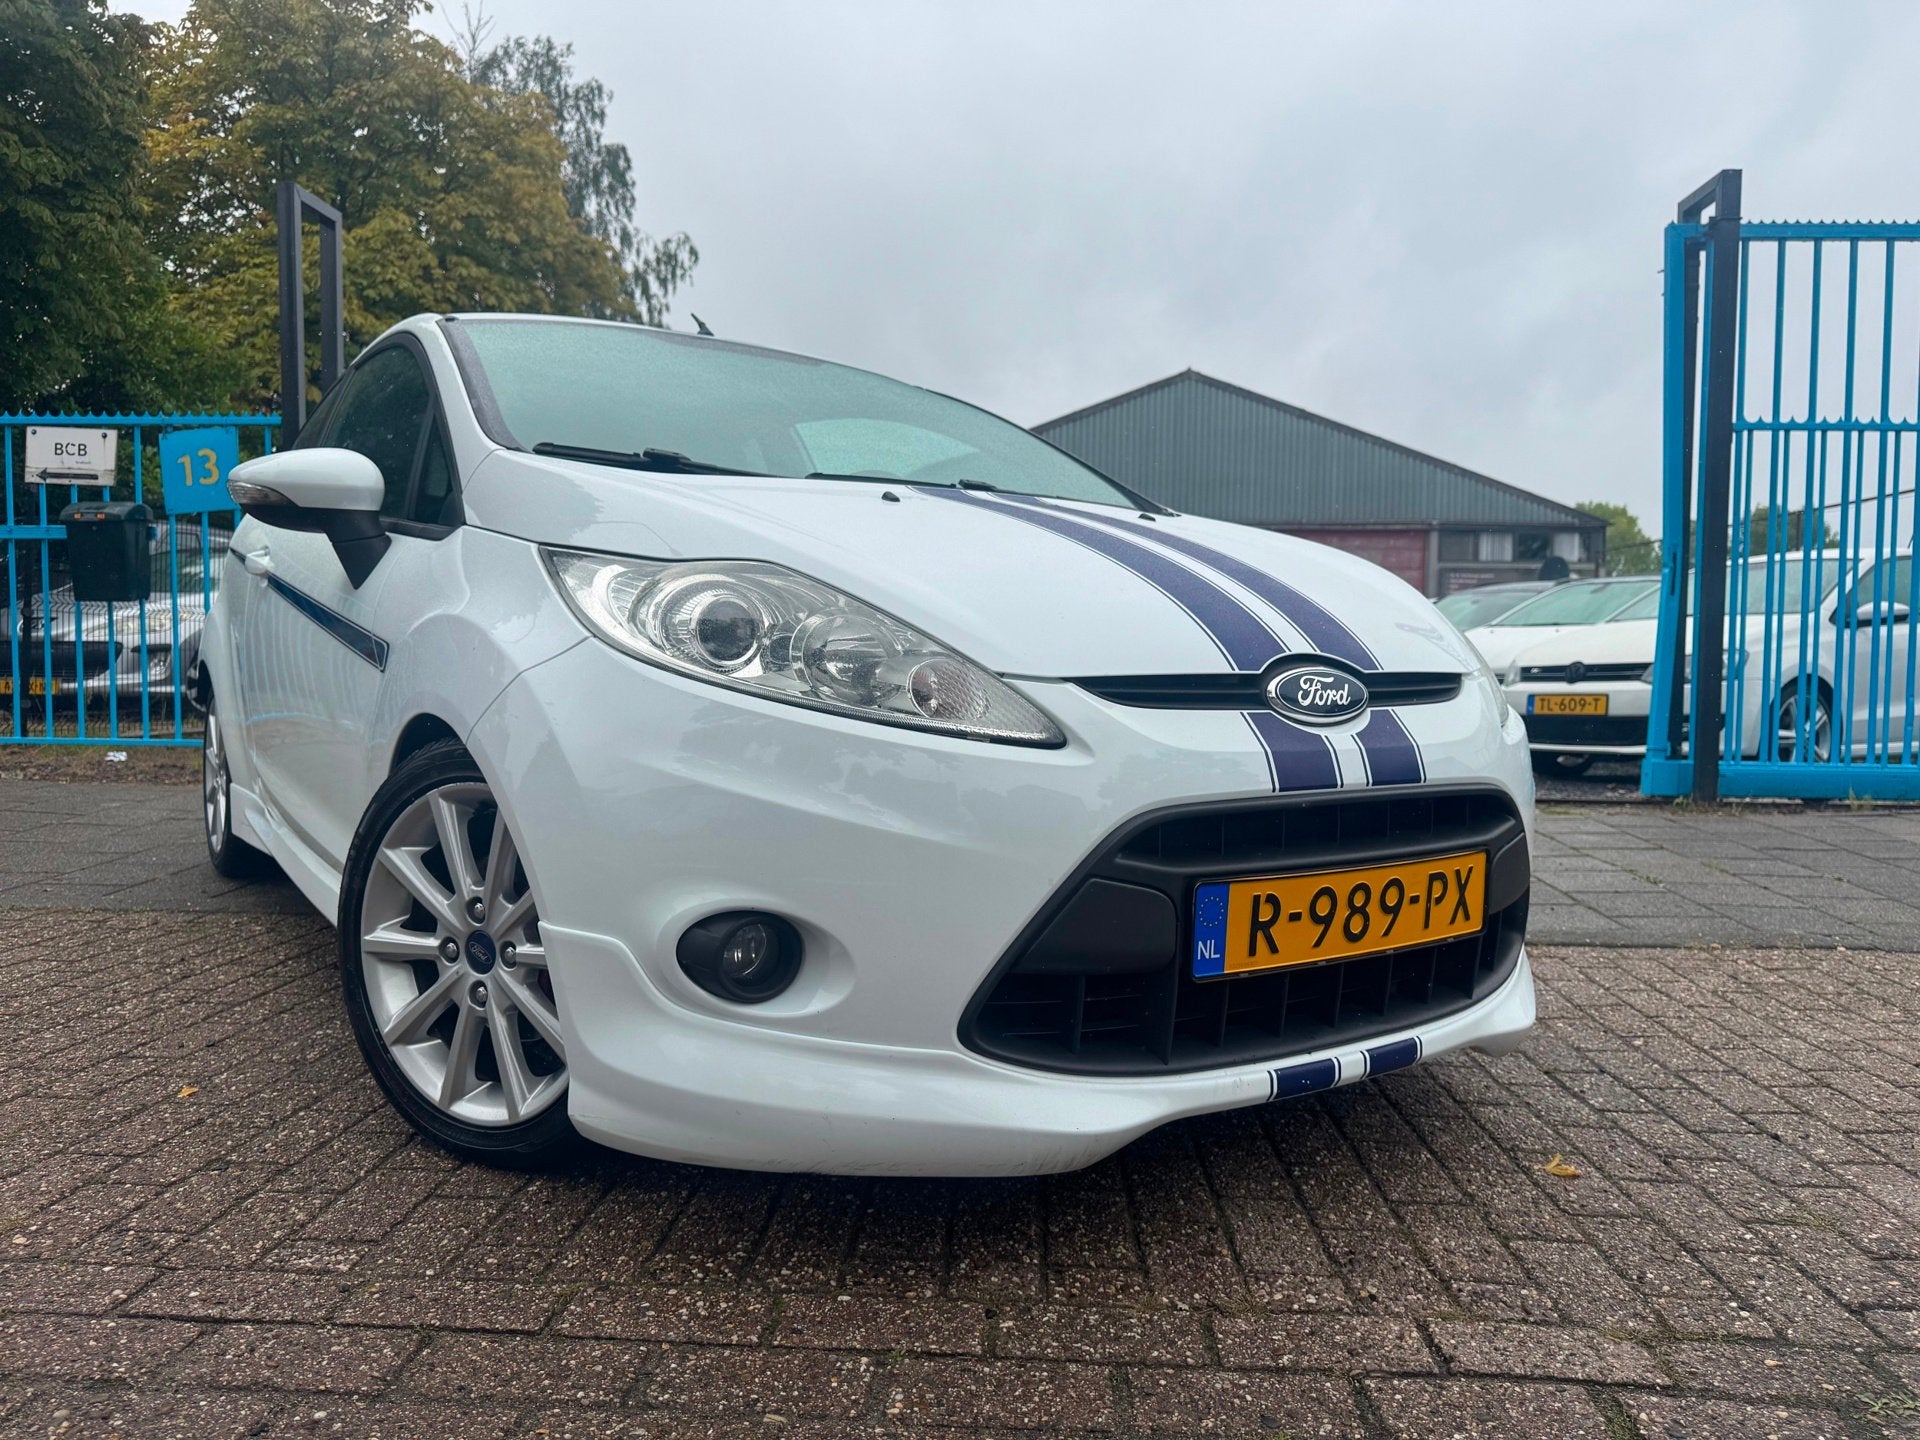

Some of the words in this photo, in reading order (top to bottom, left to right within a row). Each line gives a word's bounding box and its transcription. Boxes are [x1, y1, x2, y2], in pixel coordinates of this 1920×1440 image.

[54, 442, 88, 457] BCB
[177, 448, 219, 486] 13
[1297, 675, 1351, 706] Ford
[1539, 697, 1601, 712] TL-609-T
[1248, 864, 1474, 957] R-989-PX
[472, 944, 488, 960] Ford
[1197, 939, 1220, 961] NL
